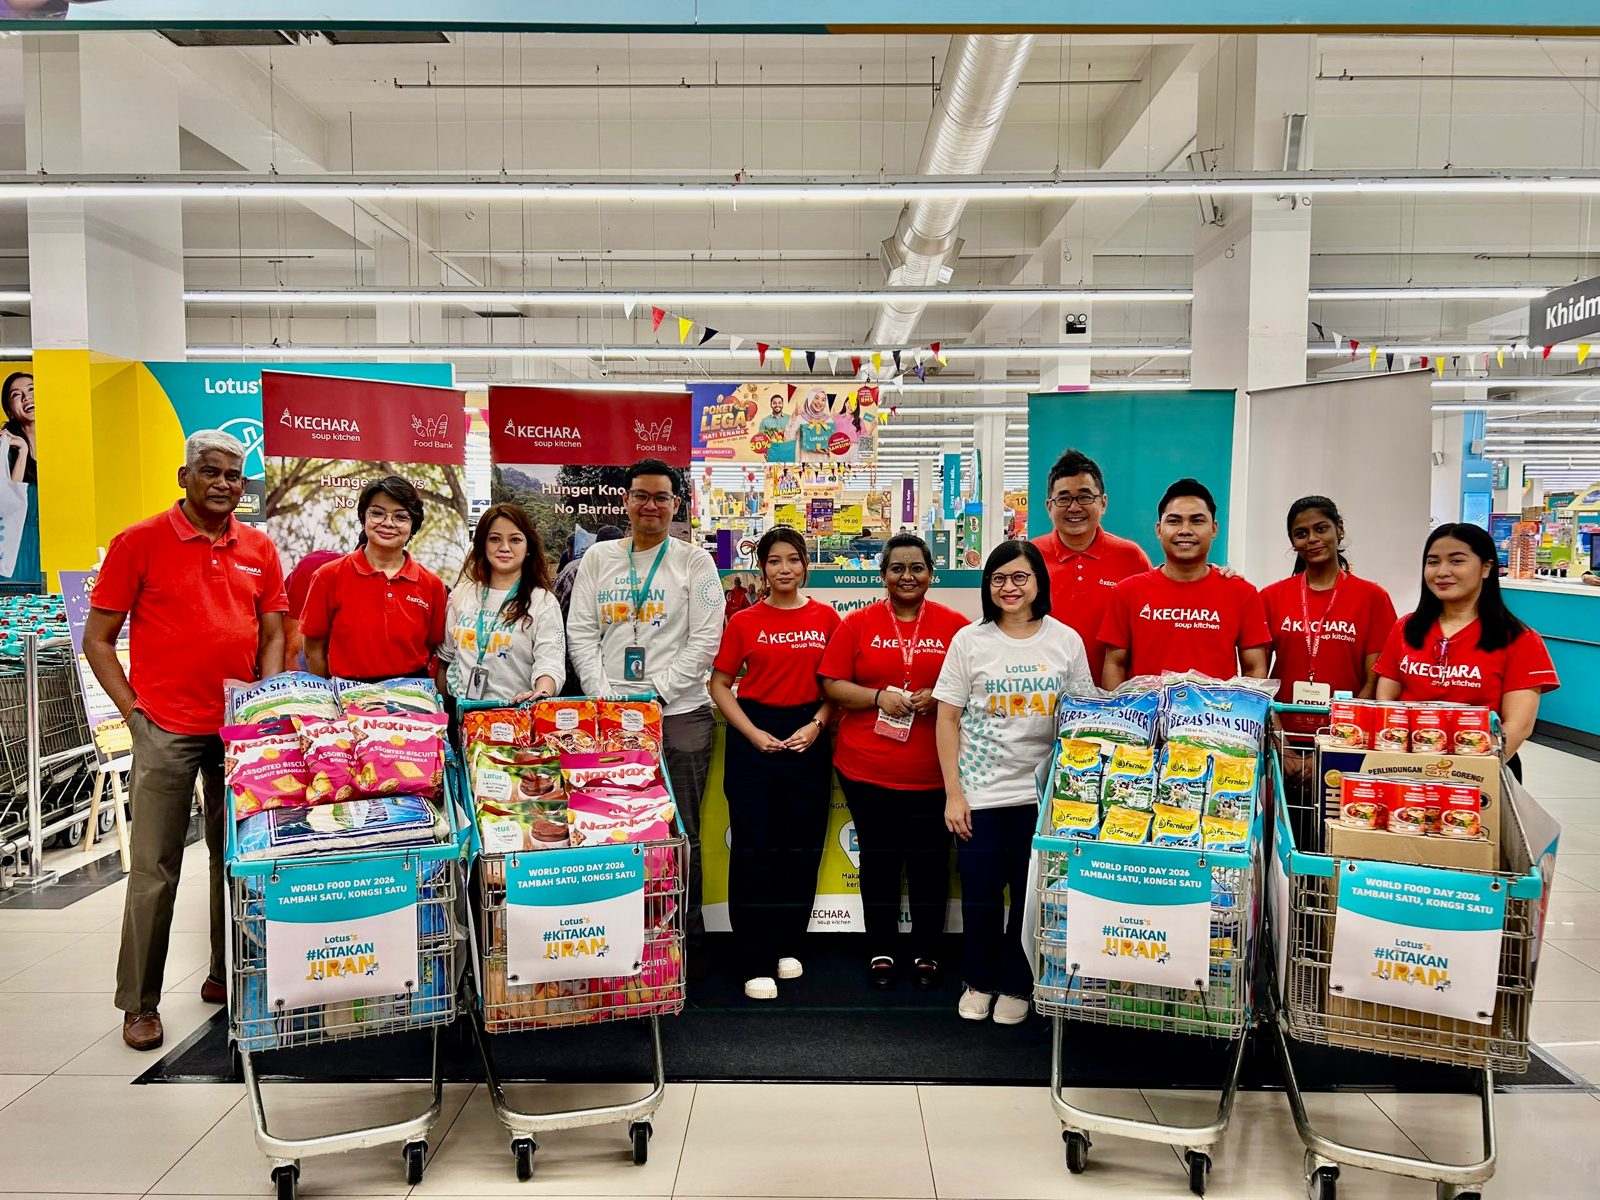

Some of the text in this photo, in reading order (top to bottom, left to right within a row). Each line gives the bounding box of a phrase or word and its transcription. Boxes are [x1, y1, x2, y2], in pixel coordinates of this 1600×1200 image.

[703, 404, 735, 415] POKET
[294, 415, 360, 433] KECHARA
[701, 411, 747, 432] LEGA
[312, 431, 360, 442] soup kitchen
[518, 425, 581, 439] KECHARA
[719, 429, 745, 438] TENANG
[414, 439, 453, 449] Food Bank
[534, 439, 582, 448] soup kitchen
[636, 443, 677, 452] Food Bank
[750, 441, 771, 451] 50%
[320, 474, 370, 491] Hunge
[542, 484, 627, 499] Hunger Kno
[335, 496, 355, 509] No
[555, 503, 629, 515] No Barrier
[834, 574, 940, 584] WORLD FO 26
[597, 589, 665, 603] #KiTAAN
[1153, 608, 1220, 622] KECHARA
[1193, 621, 1220, 630] kitchen
[1293, 620, 1357, 636] KCHARA
[769, 630, 826, 644] KECHARA
[882, 638, 945, 649] KEARA
[1332, 632, 1356, 643] kitchen
[791, 642, 808, 650] soup
[1005, 662, 1048, 674] Lotus's
[1408, 662, 1482, 680] KECHARA
[340, 681, 362, 692] BER
[1451, 679, 1482, 688] kitchen
[235, 687, 267, 710] BERAS
[1117, 708, 1149, 732] SUPER
[1169, 712, 1203, 730] BERAS
[369, 745, 439, 758] ASSORTED BISCUITS
[242, 761, 306, 777] ASSORTED BISCU
[1125, 761, 1148, 772] Fernlea
[254, 771, 275, 780] BISKUT
[575, 766, 647, 783] NaxNax
[1368, 766, 1485, 783] PERLINDUNGAN GORENG!
[1166, 816, 1193, 831] Fernleaf
[528, 861, 625, 877] WORLD FOOD DAY 2026
[1091, 860, 1190, 877] WORLD FOOD DAY 2026
[517, 870, 636, 889] TAMBAH SATU, KONGSI SATU
[842, 872, 860, 880] Maka
[1080, 869, 1202, 889] TAMBAH SATU, KONGSI SATU
[290, 876, 396, 893] WORLD FOOD DAY 2026
[846, 880, 861, 888] keri
[1365, 877, 1481, 902] WORLD FOOD DAY 2026
[278, 884, 408, 905] TAMBAH SATU, KONGSI SATU
[1351, 886, 1494, 915] TAMBAH SATU, KONGSI SATU
[559, 916, 591, 927] Lotus's
[1119, 915, 1151, 926] Lotus's
[324, 933, 358, 944] Lotus's
[1395, 938, 1432, 951] Lotus's
[542, 937, 607, 961] JIRAN
[1101, 937, 1168, 961] JIRAN
[305, 954, 376, 982] JIRAN
[1370, 960, 1449, 988] JIRAN
